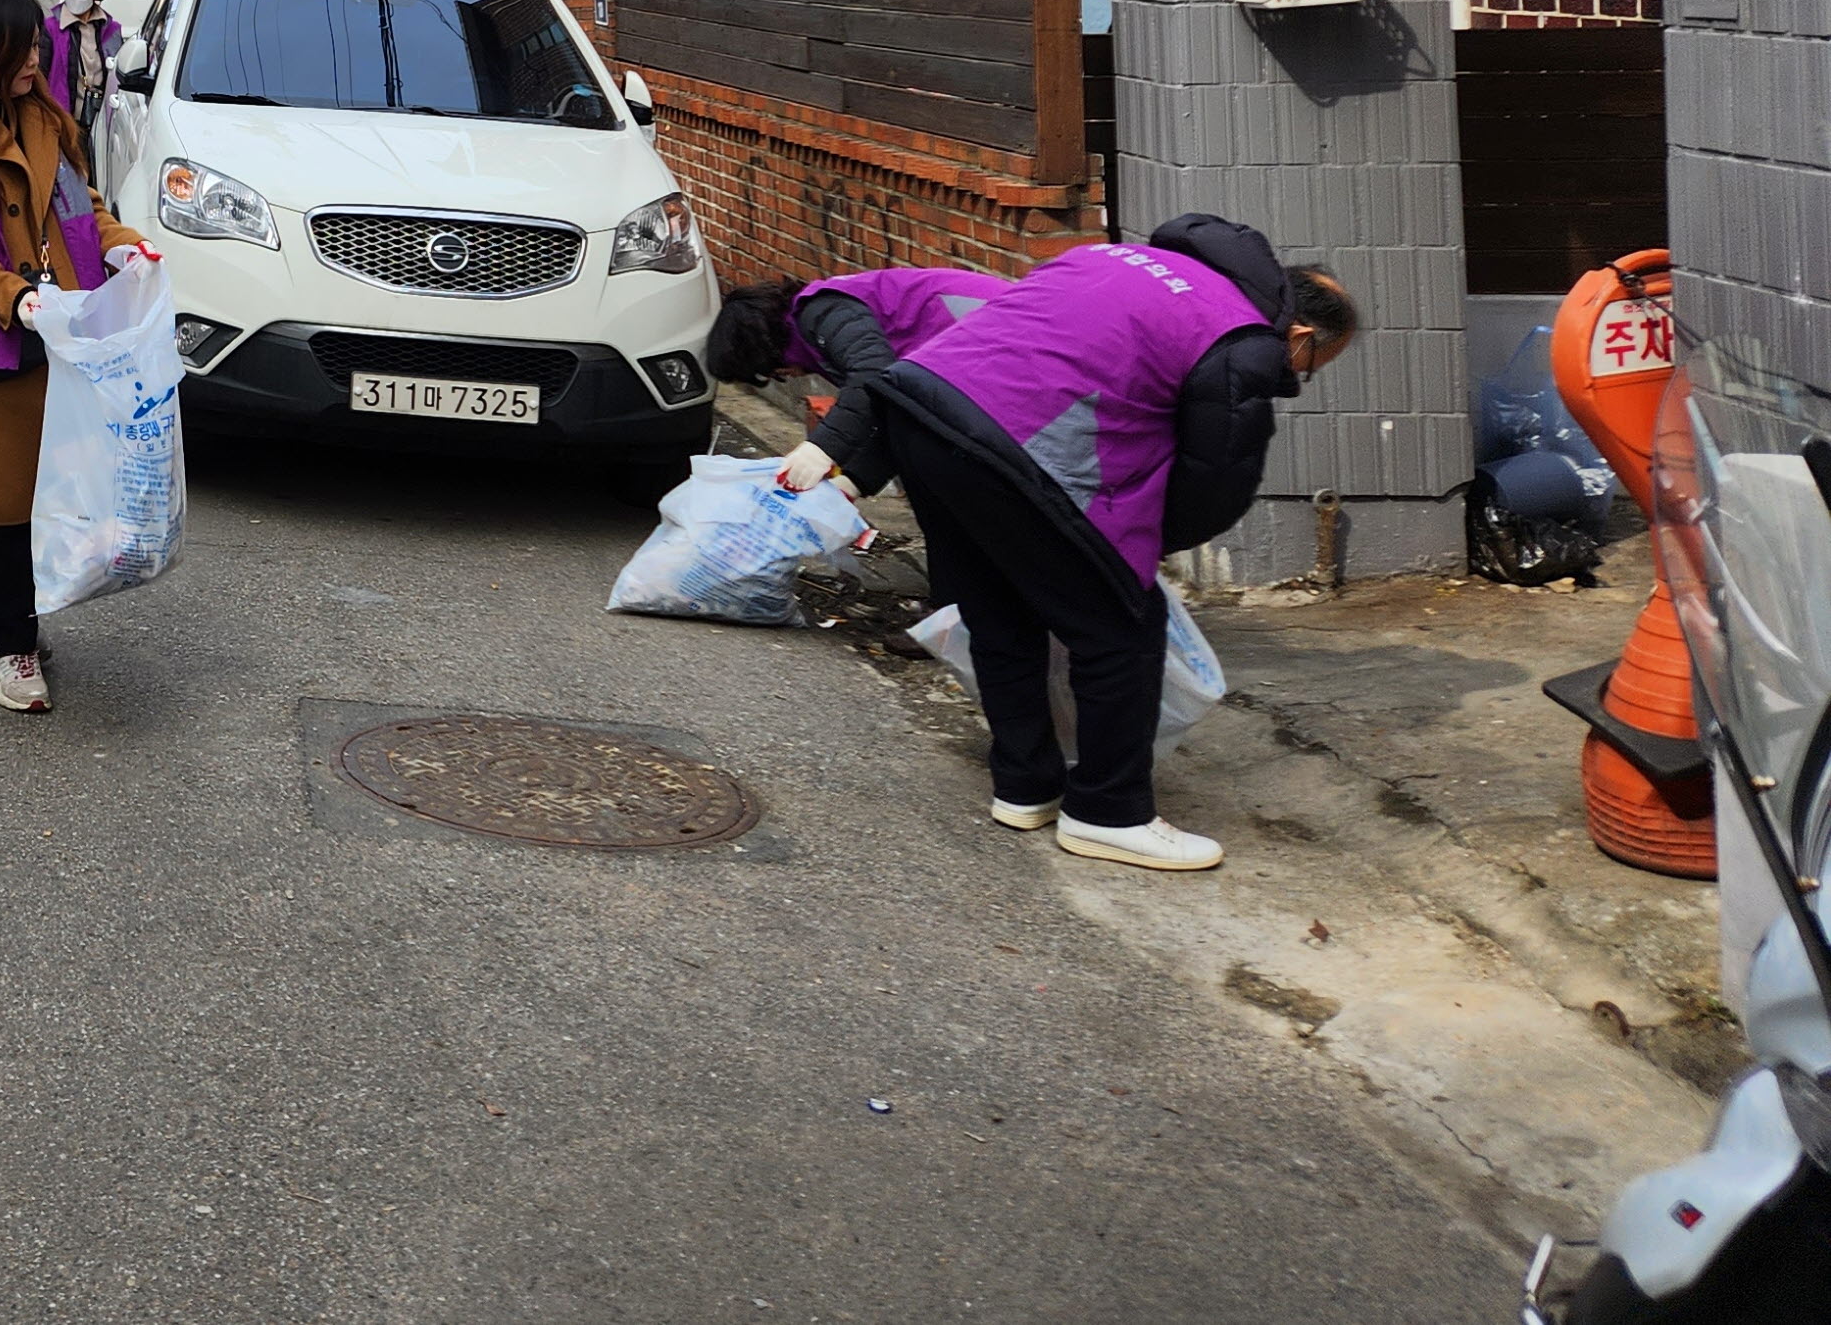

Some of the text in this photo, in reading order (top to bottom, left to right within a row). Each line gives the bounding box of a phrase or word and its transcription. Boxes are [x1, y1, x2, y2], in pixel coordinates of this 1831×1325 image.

[1604, 315, 1674, 368] 주차
[363, 378, 528, 418] 311마 7325
